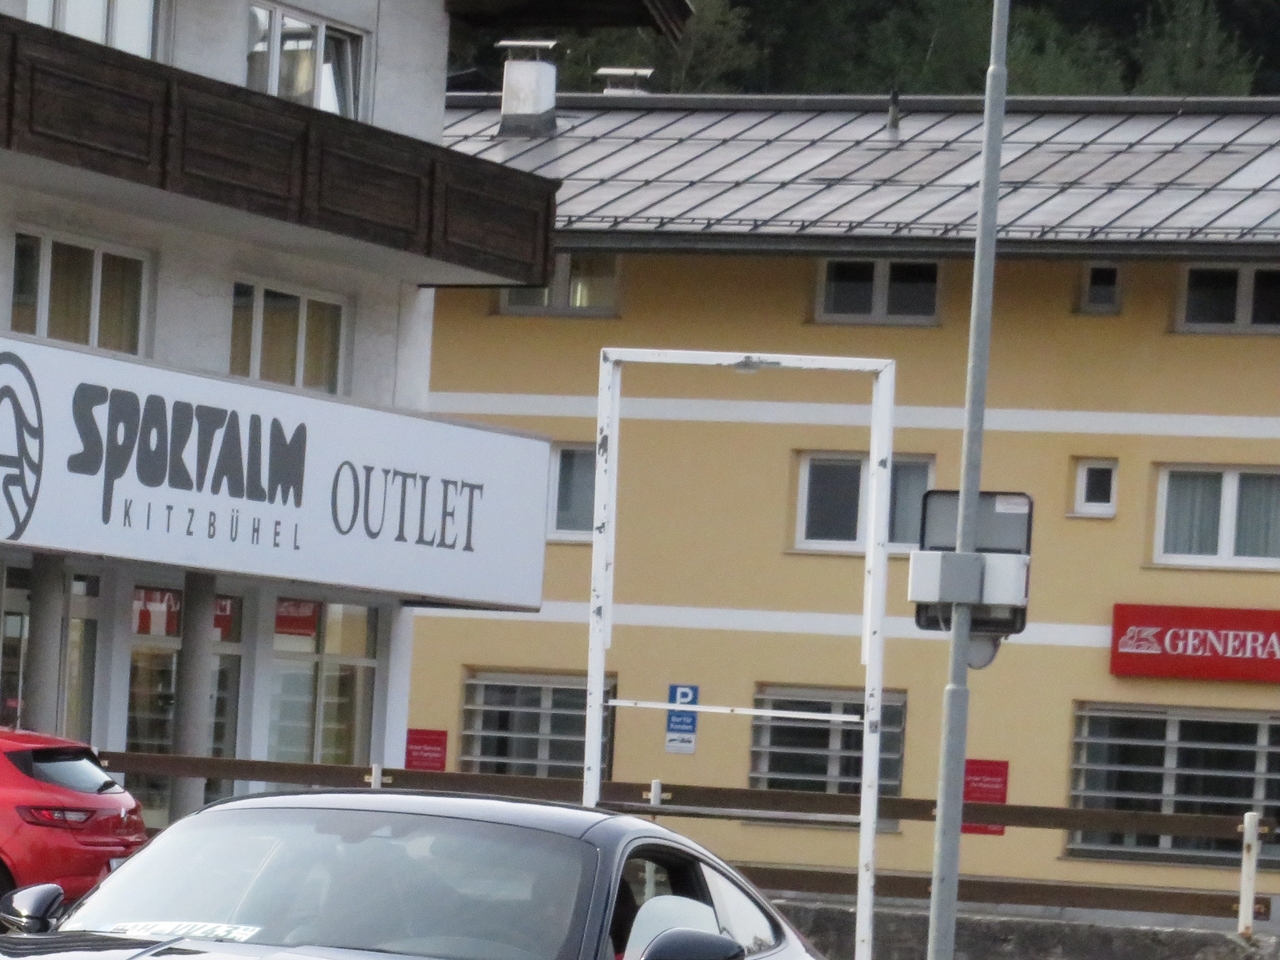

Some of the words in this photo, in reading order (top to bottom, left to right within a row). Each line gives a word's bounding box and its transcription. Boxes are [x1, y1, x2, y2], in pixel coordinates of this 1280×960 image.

[67, 382, 307, 525] SPORTALM
[123, 499, 300, 550] KITZBÜHEL
[331, 461, 484, 552] OUTLET
[676, 687, 693, 711] P
